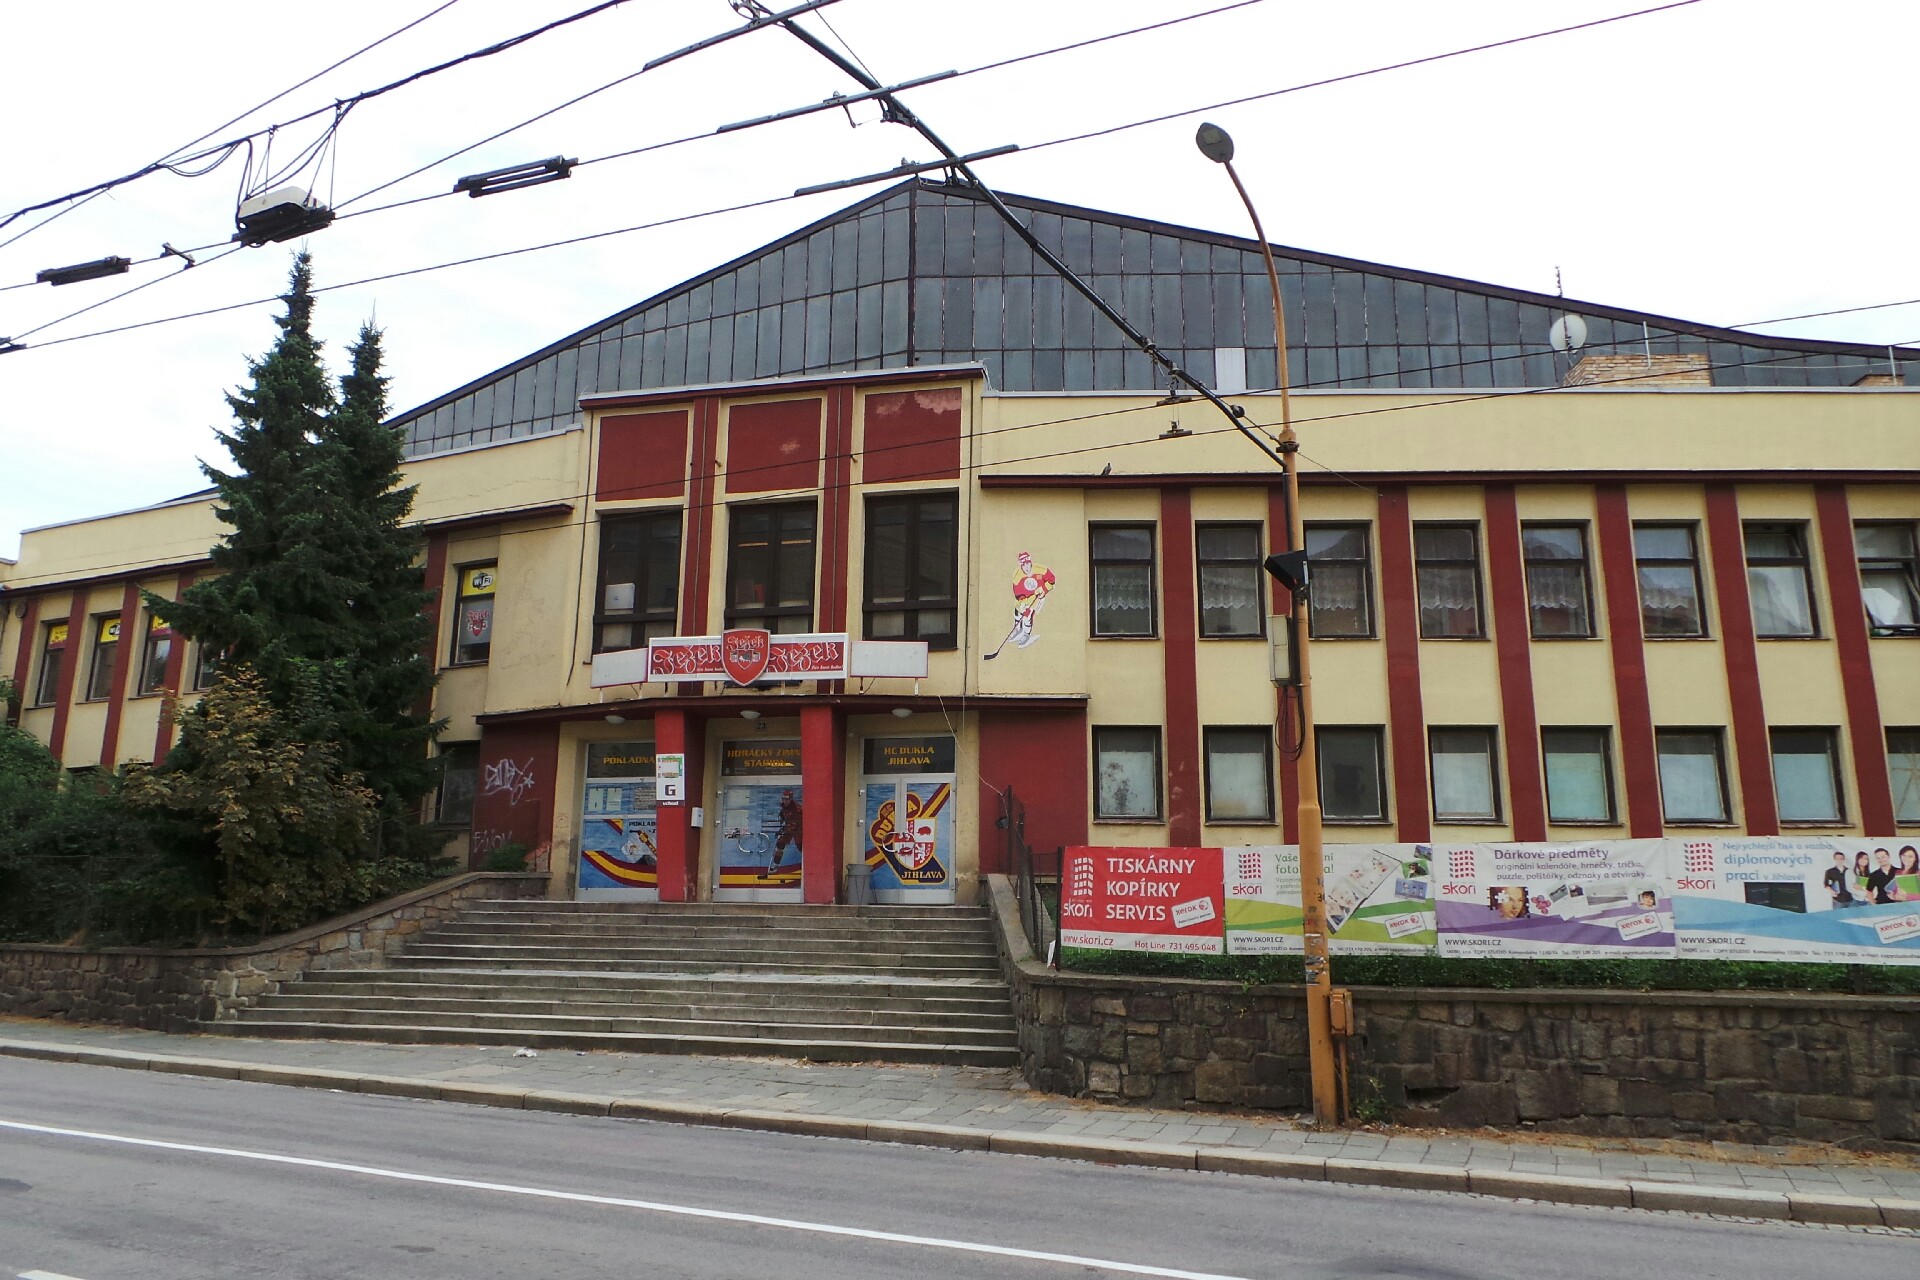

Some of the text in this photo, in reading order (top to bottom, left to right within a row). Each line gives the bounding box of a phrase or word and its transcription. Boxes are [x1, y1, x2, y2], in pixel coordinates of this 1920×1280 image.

[725, 635, 765, 651] Ježek
[652, 644, 721, 675] Ježek
[765, 641, 839, 673] Ježek
[884, 746, 935, 755] HC DUKLA
[603, 756, 656, 765] POKLADNA
[888, 757, 931, 765] JIHLAVA
[665, 784, 676, 797] G
[1275, 854, 1299, 863] Vaše
[1494, 848, 1609, 861] Dárkové předměty
[1724, 853, 1813, 867] diplomových
[1106, 855, 1196, 874] TISKÁRNY
[901, 871, 943, 879] JIHLAVA
[1568, 872, 1601, 880] odznaky
[1726, 870, 1759, 882] prací
[1106, 878, 1181, 897] KOPÍRKY
[1232, 883, 1263, 896] skori
[1442, 881, 1476, 895] skori
[1677, 876, 1716, 890] skori
[1063, 898, 1093, 918] skori
[1106, 904, 1166, 921] SERVIS
[1175, 905, 1198, 916] xerox
[1389, 918, 1410, 928] xerox
[1620, 919, 1643, 930] xerox
[1880, 922, 1905, 932] xerox
[1063, 934, 1114, 947] www.skori.cz
[1135, 941, 1149, 949] Hot
[1150, 941, 1166, 950] Line
[1185, 943, 1199, 951] 495
[1680, 937, 1746, 945] WWW.SKORI.CZ
